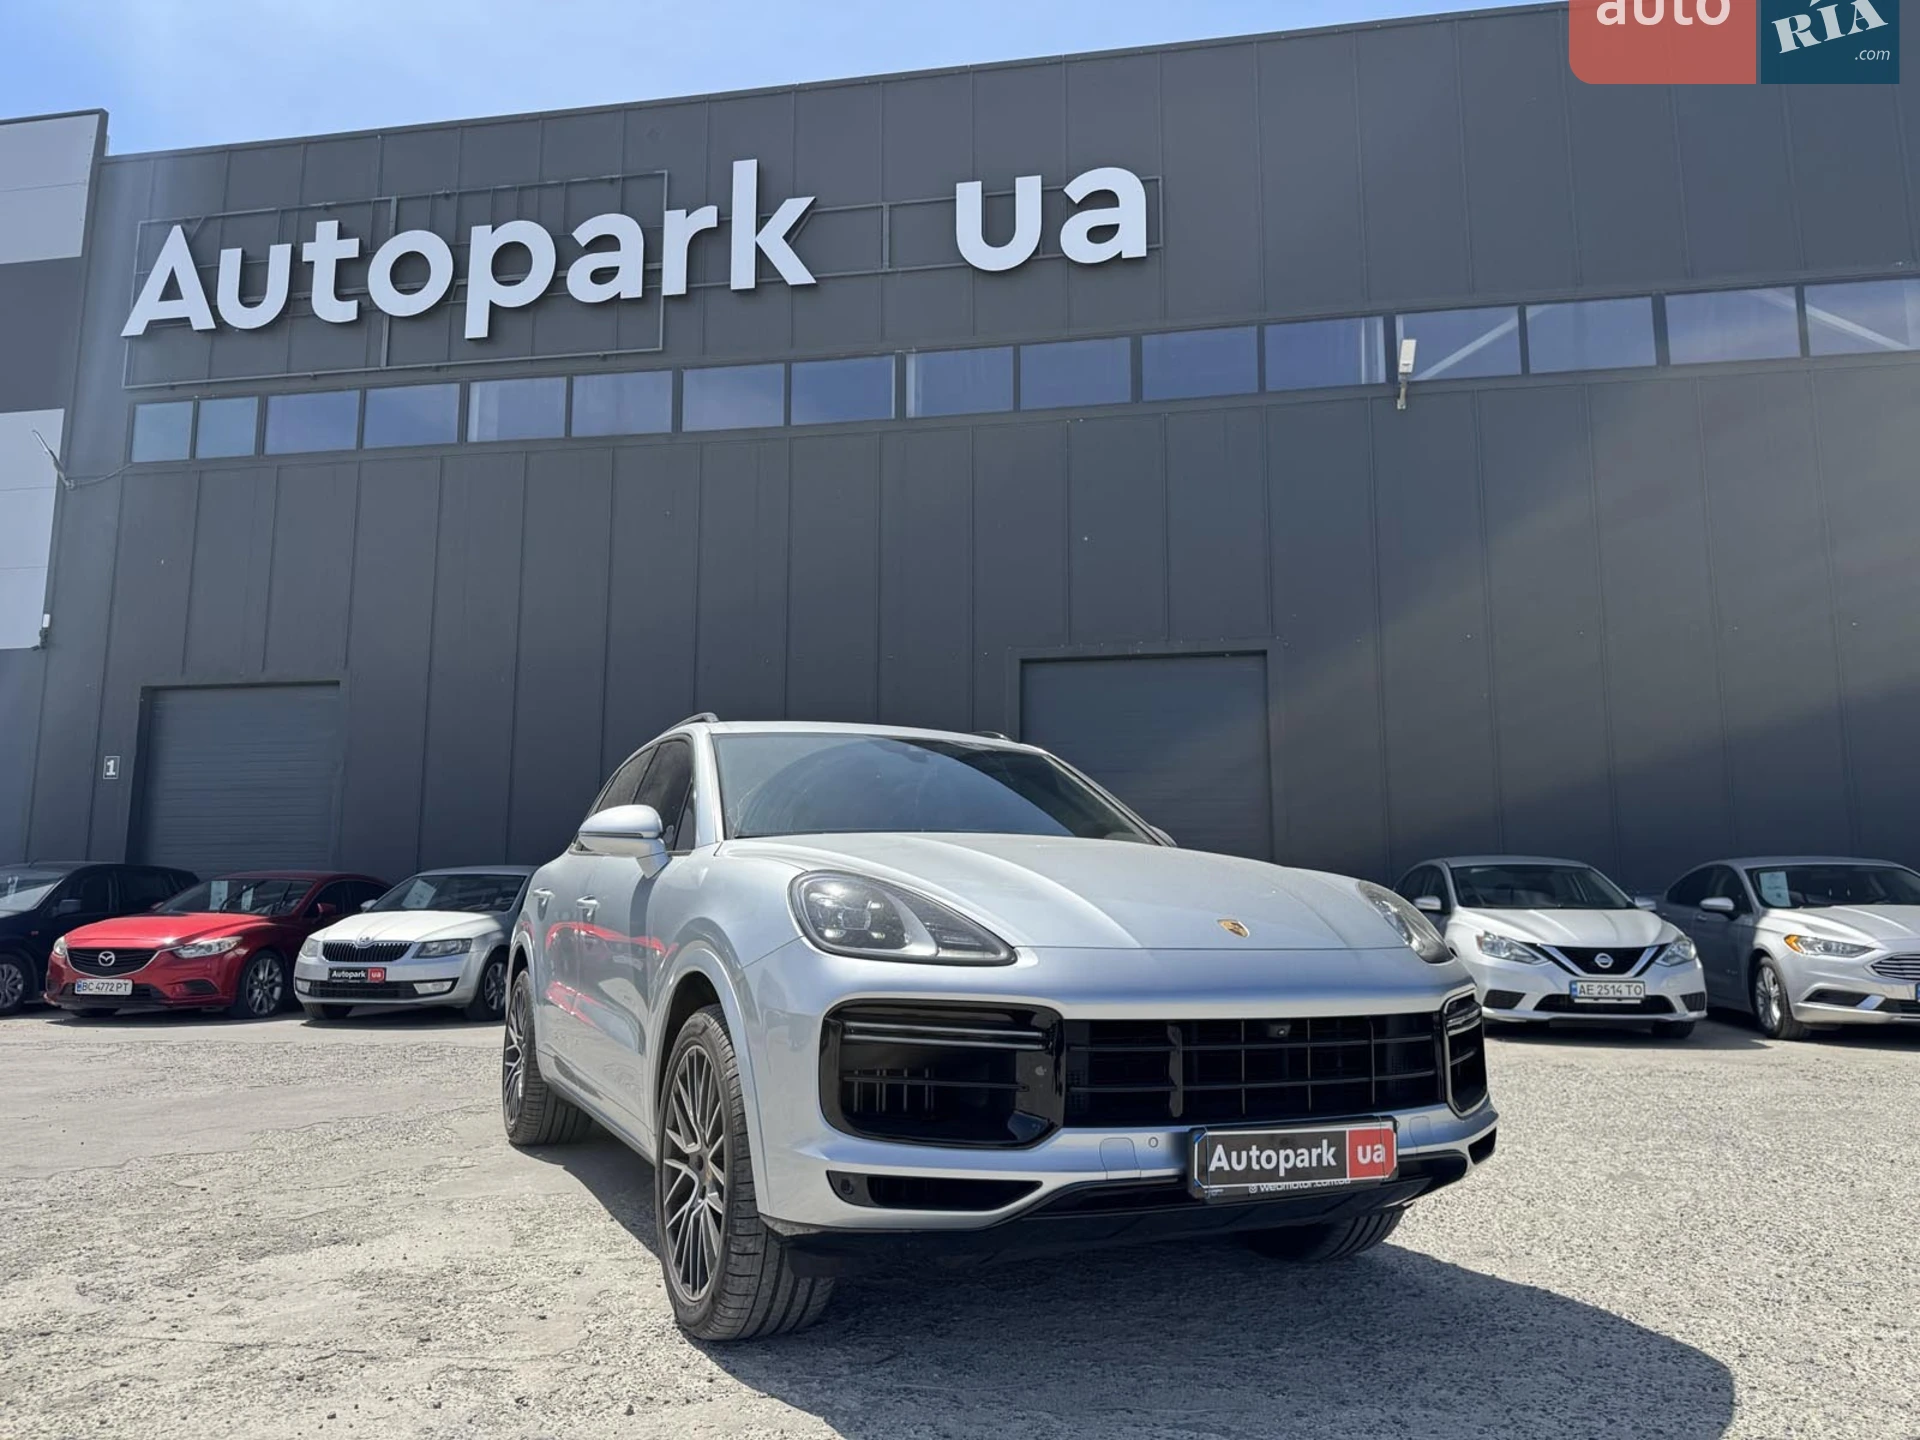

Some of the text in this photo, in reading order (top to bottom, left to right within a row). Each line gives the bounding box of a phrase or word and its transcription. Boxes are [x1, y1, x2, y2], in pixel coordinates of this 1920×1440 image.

[121, 158, 1148, 341] Autopark ua
[106, 759, 116, 776] 1
[331, 970, 366, 979] Autopark
[82, 982, 129, 992] BC 4772 PT
[1579, 984, 1643, 996] AE 2514 TO
[1208, 1138, 1386, 1178] Autopark ua
